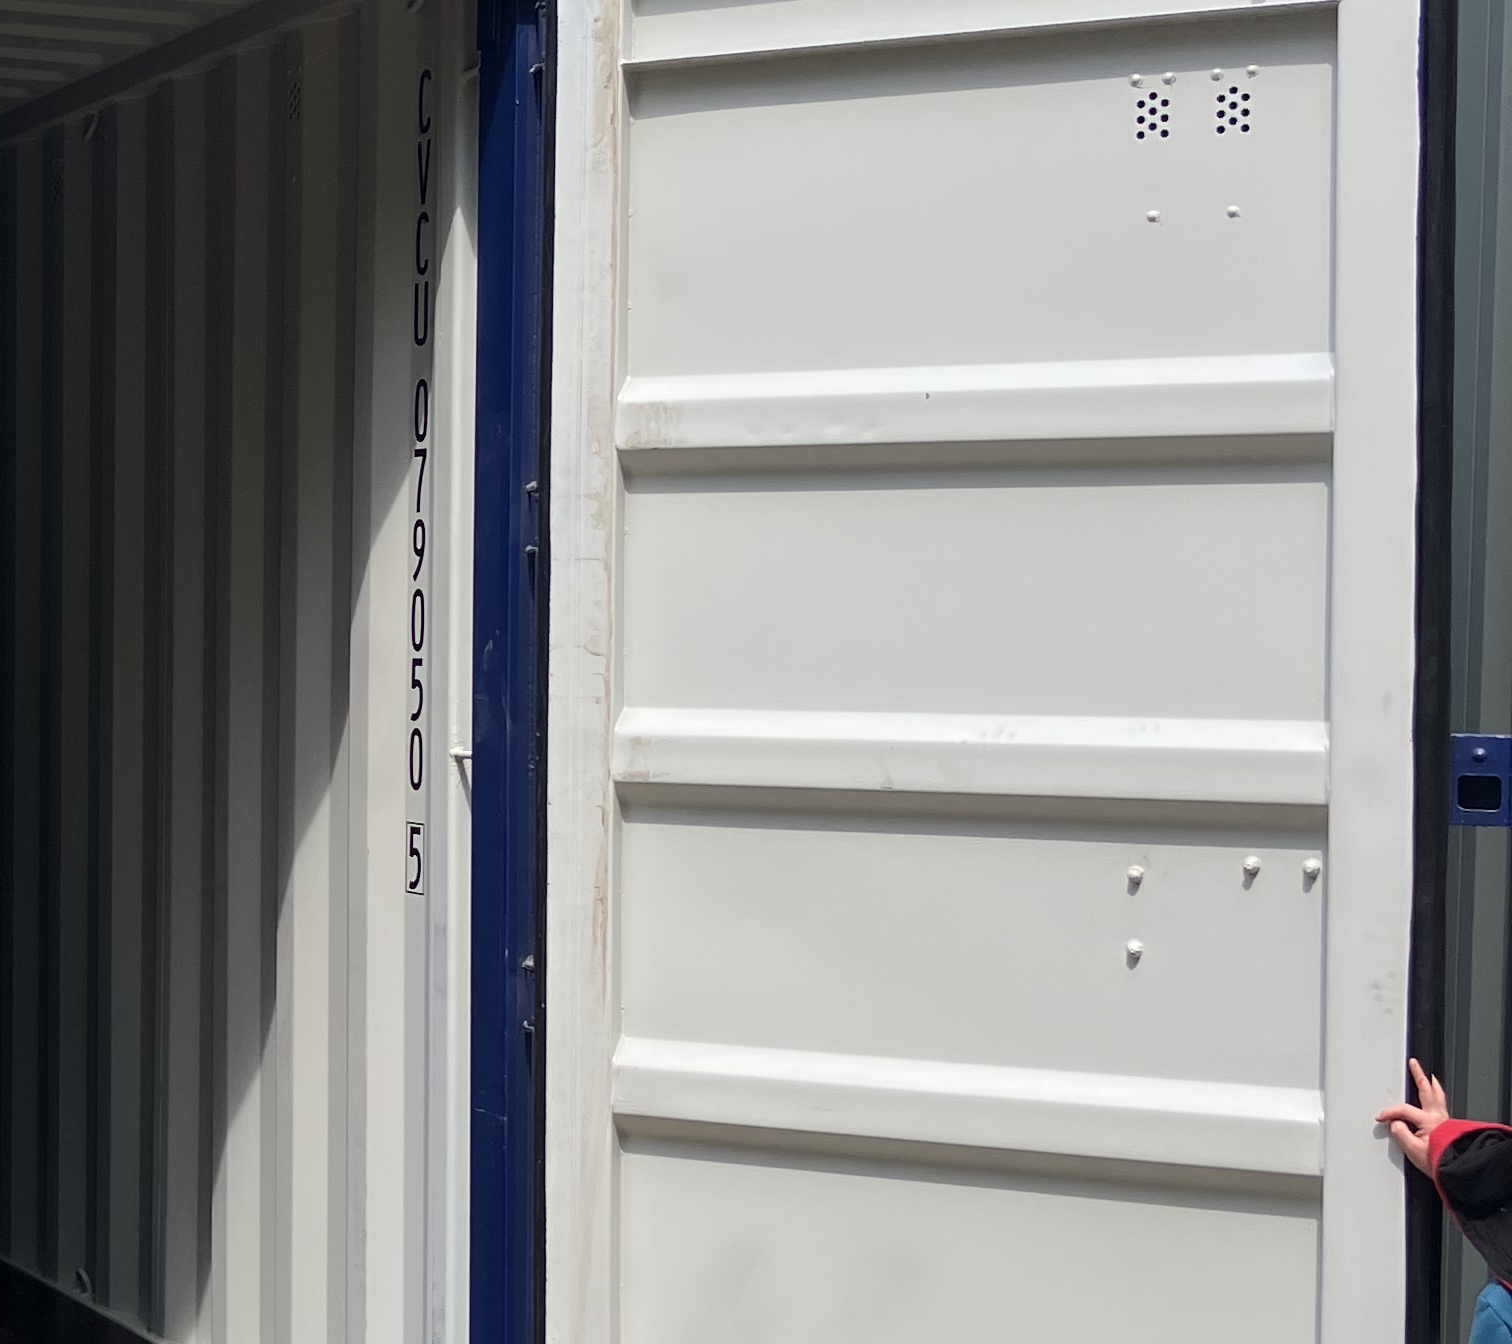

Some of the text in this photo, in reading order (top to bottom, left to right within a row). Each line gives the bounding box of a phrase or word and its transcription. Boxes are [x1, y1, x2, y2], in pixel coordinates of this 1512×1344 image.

[408, 68, 432, 891] CVCU 079050 5
